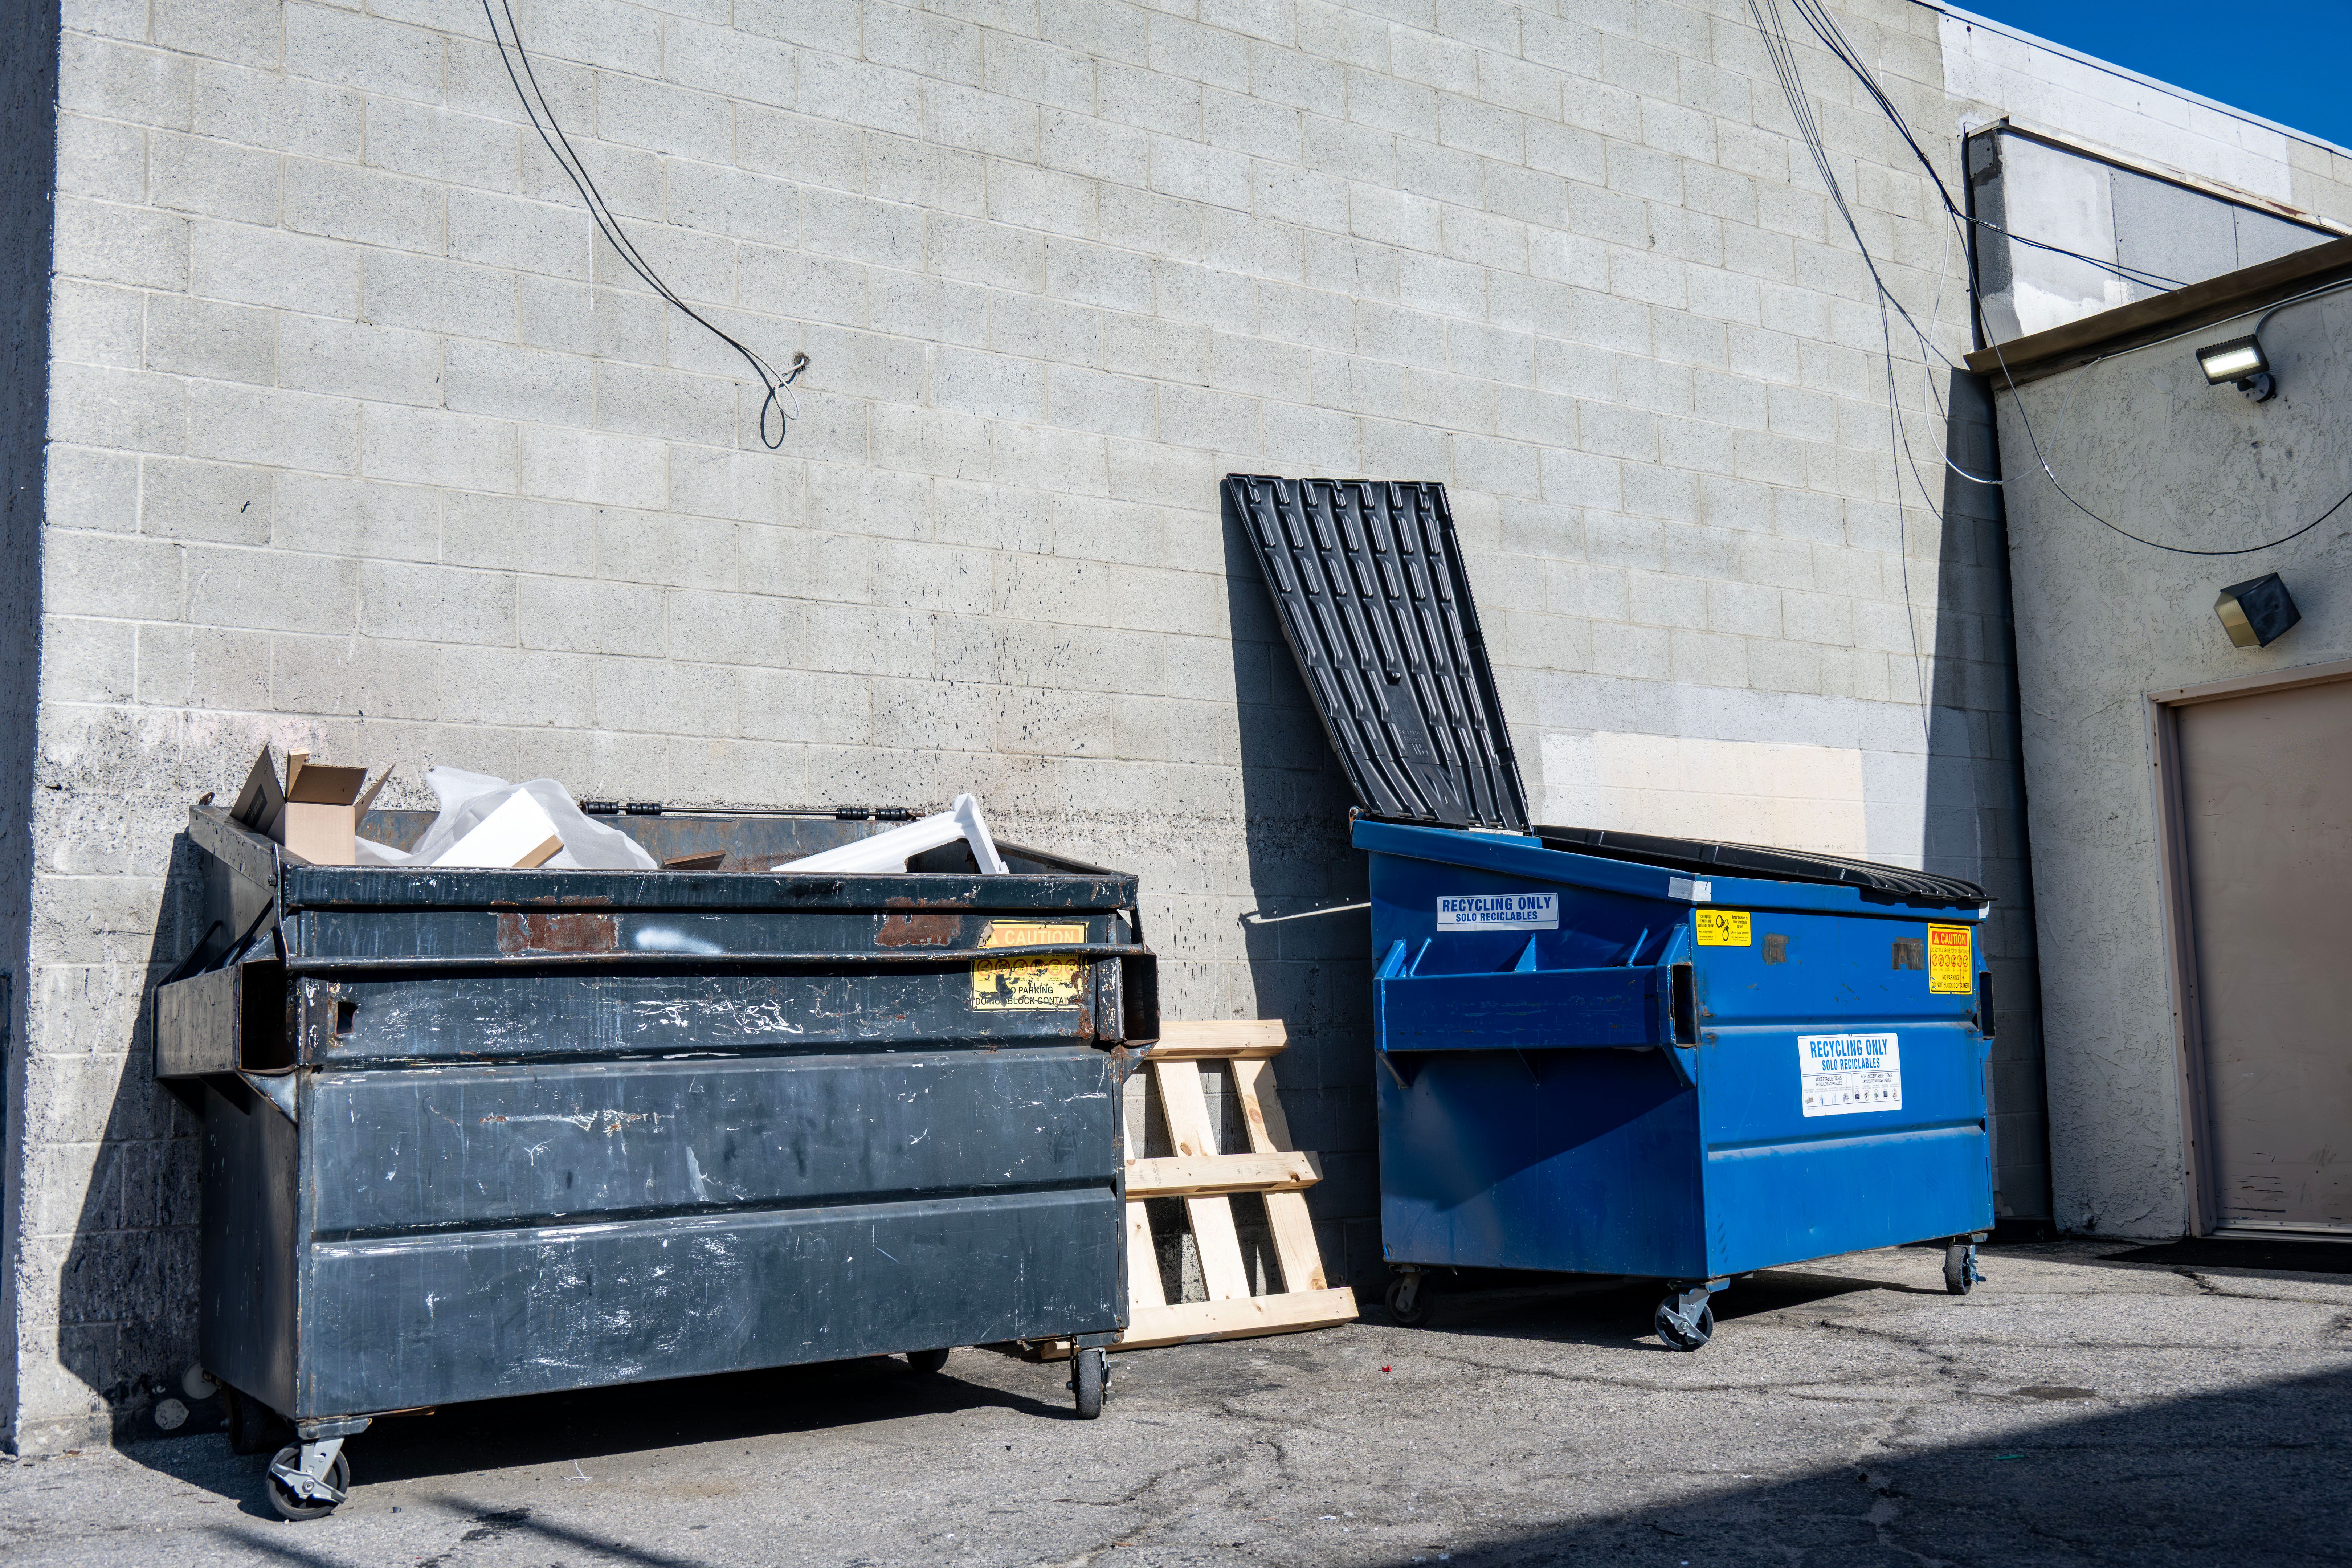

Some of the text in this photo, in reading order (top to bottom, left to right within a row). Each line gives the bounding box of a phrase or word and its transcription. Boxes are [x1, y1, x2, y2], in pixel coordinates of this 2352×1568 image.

[1442, 896, 1552, 912] RECYCLING ONLY
[1456, 911, 1538, 922] SOLO RECICLABLES
[1005, 930, 1074, 945] CAUTION
[1941, 933, 1966, 945] CAUTION
[1810, 1039, 1887, 1058] RECYCLING ONLY
[1822, 1057, 1880, 1071] SOLO RECICLABLES
